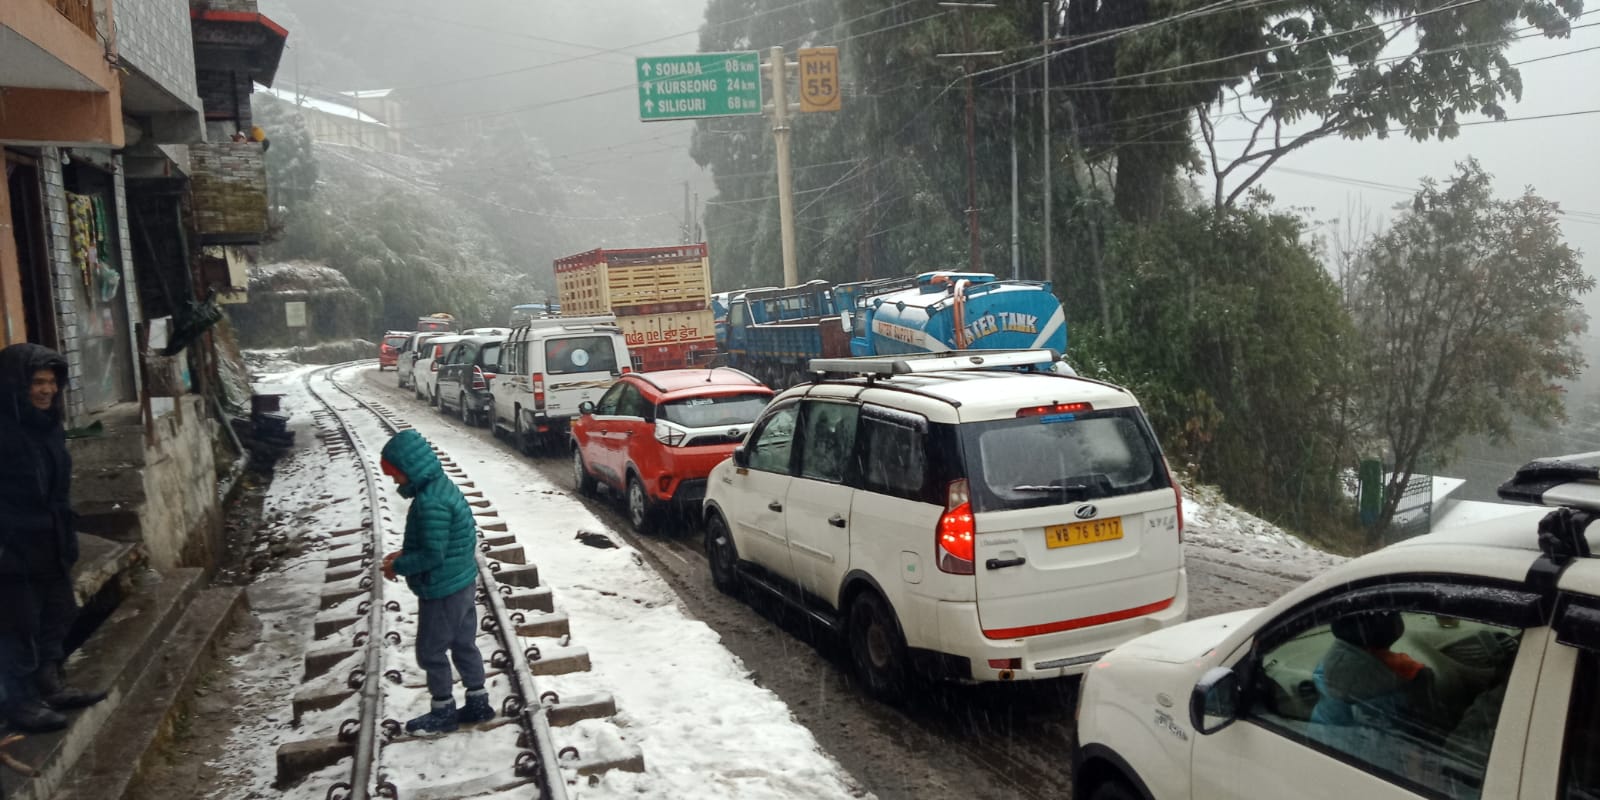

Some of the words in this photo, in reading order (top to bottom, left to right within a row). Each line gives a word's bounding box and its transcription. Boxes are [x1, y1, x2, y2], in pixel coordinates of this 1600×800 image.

[656, 61, 703, 76] SONADA
[741, 62, 755, 73] km
[806, 61, 831, 75] NH
[657, 79, 717, 95] KURSEONG
[727, 78, 740, 91] 24
[741, 79, 756, 90] km
[807, 78, 833, 96] 55
[658, 97, 706, 113] SILIGURI
[728, 96, 742, 109] 68
[742, 99, 756, 109] km
[948, 313, 999, 348] ATER
[998, 311, 1038, 334] TANK
